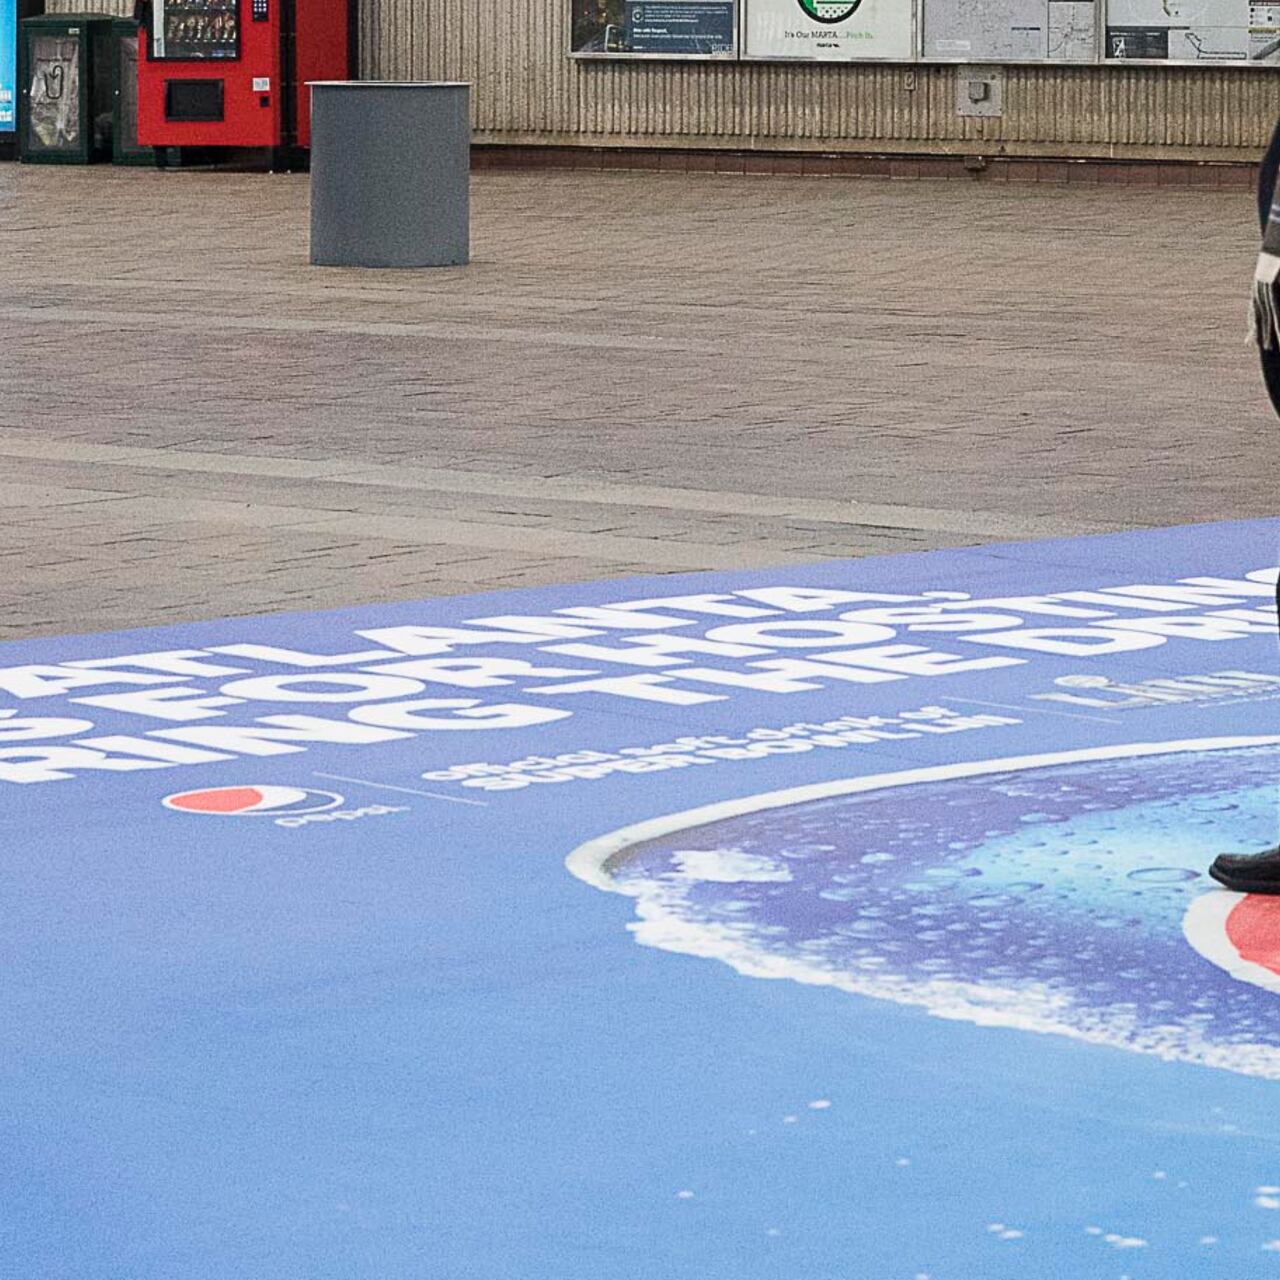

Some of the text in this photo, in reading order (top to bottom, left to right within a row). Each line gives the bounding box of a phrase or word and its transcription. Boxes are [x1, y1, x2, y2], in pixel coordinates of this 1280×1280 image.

[68, 656, 604, 723] FOR
[535, 567, 1279, 668] HOSTIN
[521, 643, 1030, 706] THE
[420, 748, 620, 782] official
[618, 735, 736, 757] soft
[461, 752, 705, 791] SUPER
[706, 730, 923, 762] BOWL
